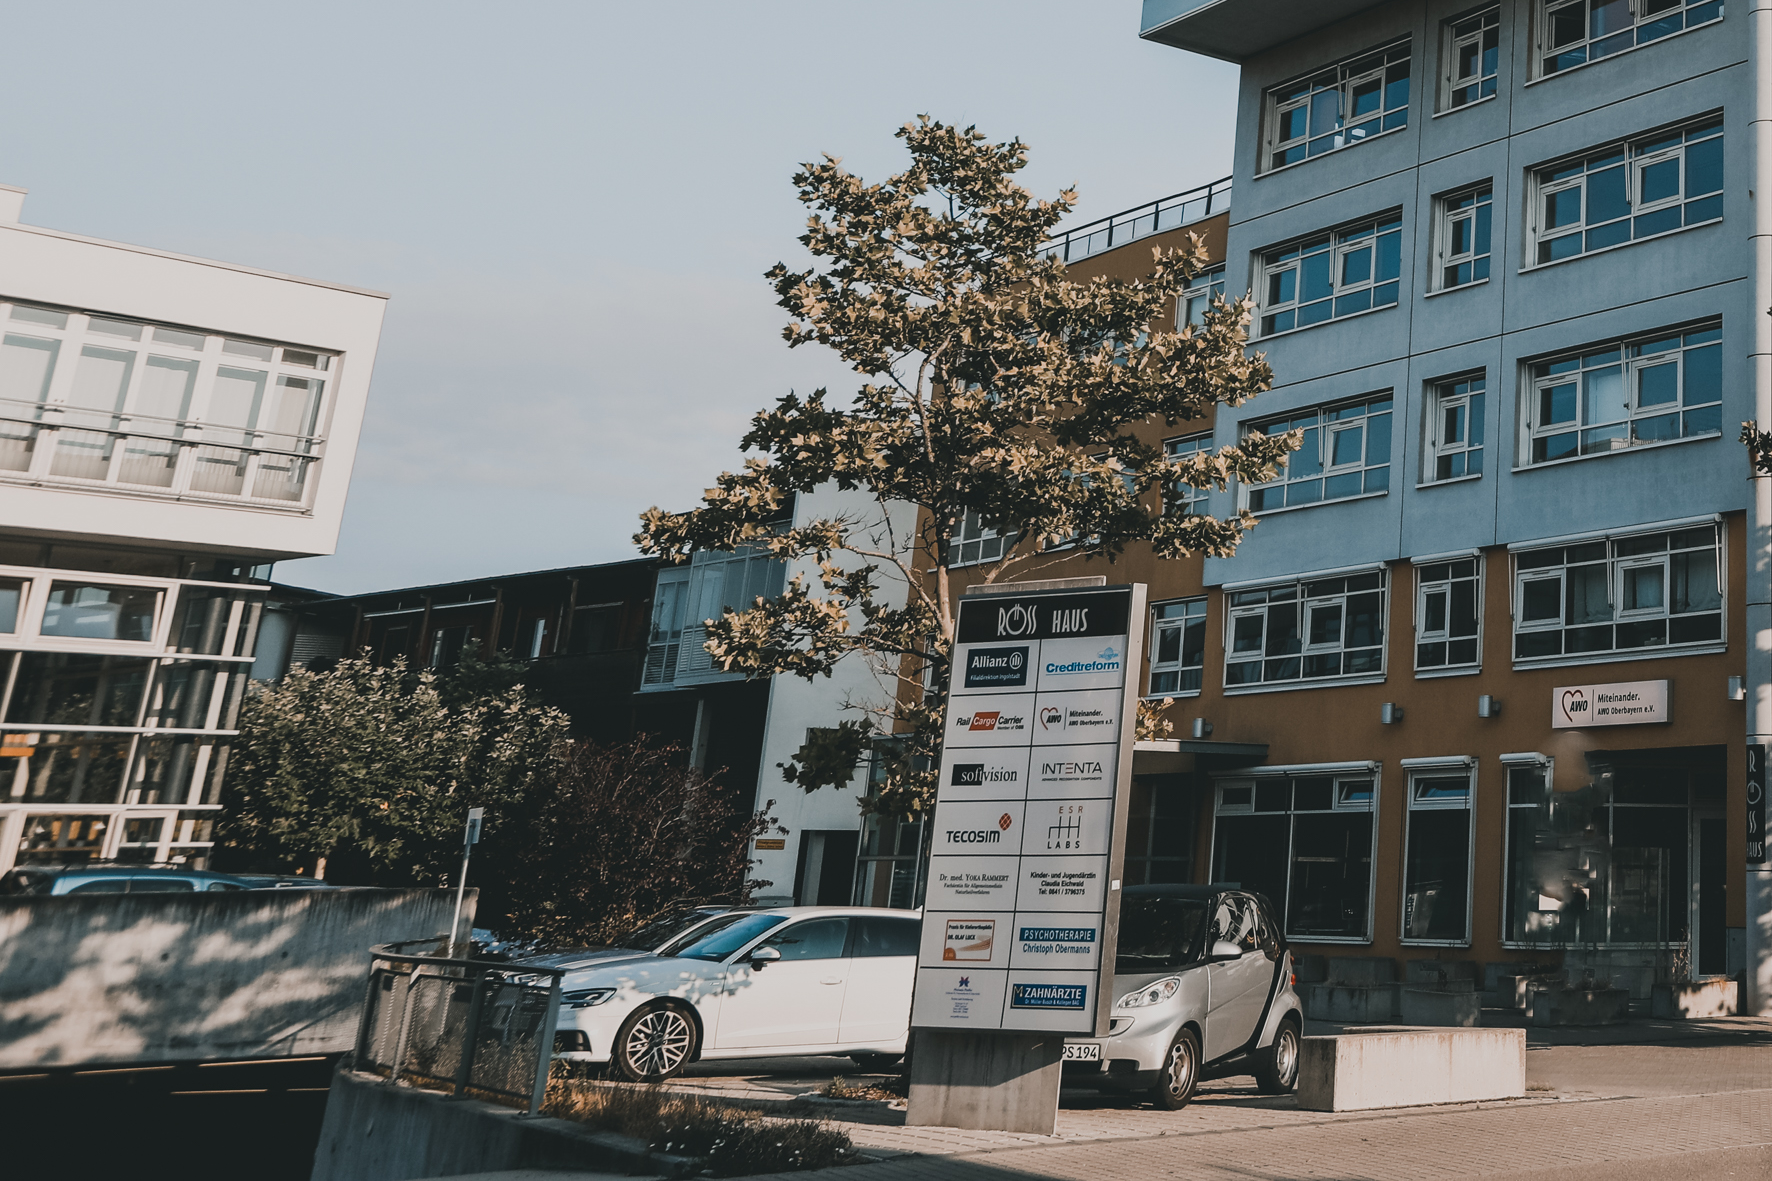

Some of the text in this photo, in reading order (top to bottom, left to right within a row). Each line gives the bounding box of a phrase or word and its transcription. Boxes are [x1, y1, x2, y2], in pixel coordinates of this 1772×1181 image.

[997, 604, 1089, 636] RÖSS HAUS
[972, 655, 1008, 668] Allianz
[1046, 661, 1119, 673] Creditreform
[1598, 692, 1640, 703] Miteinander.
[1570, 700, 1588, 712] AWO
[1611, 706, 1642, 716] Oberbayern
[1644, 705, 1655, 713] e.V.
[1046, 714, 1062, 724] AWO
[1069, 710, 1103, 718] Miteinander.
[956, 715, 1024, 727] Rail Cargo Carrier
[1080, 719, 1104, 727] Oberbayern
[961, 766, 1017, 782] softvision
[1042, 762, 1102, 774] INTENTA
[946, 830, 1000, 843] TECOSIM
[1062, 872, 1096, 880] Jugendärztin
[1024, 929, 1091, 940] PSYCHOTHERAPIE
[1023, 943, 1090, 956] Christoph Obermanns
[1025, 986, 1082, 999] ZAHNÄRZTE
[1076, 1045, 1097, 1059] 194
